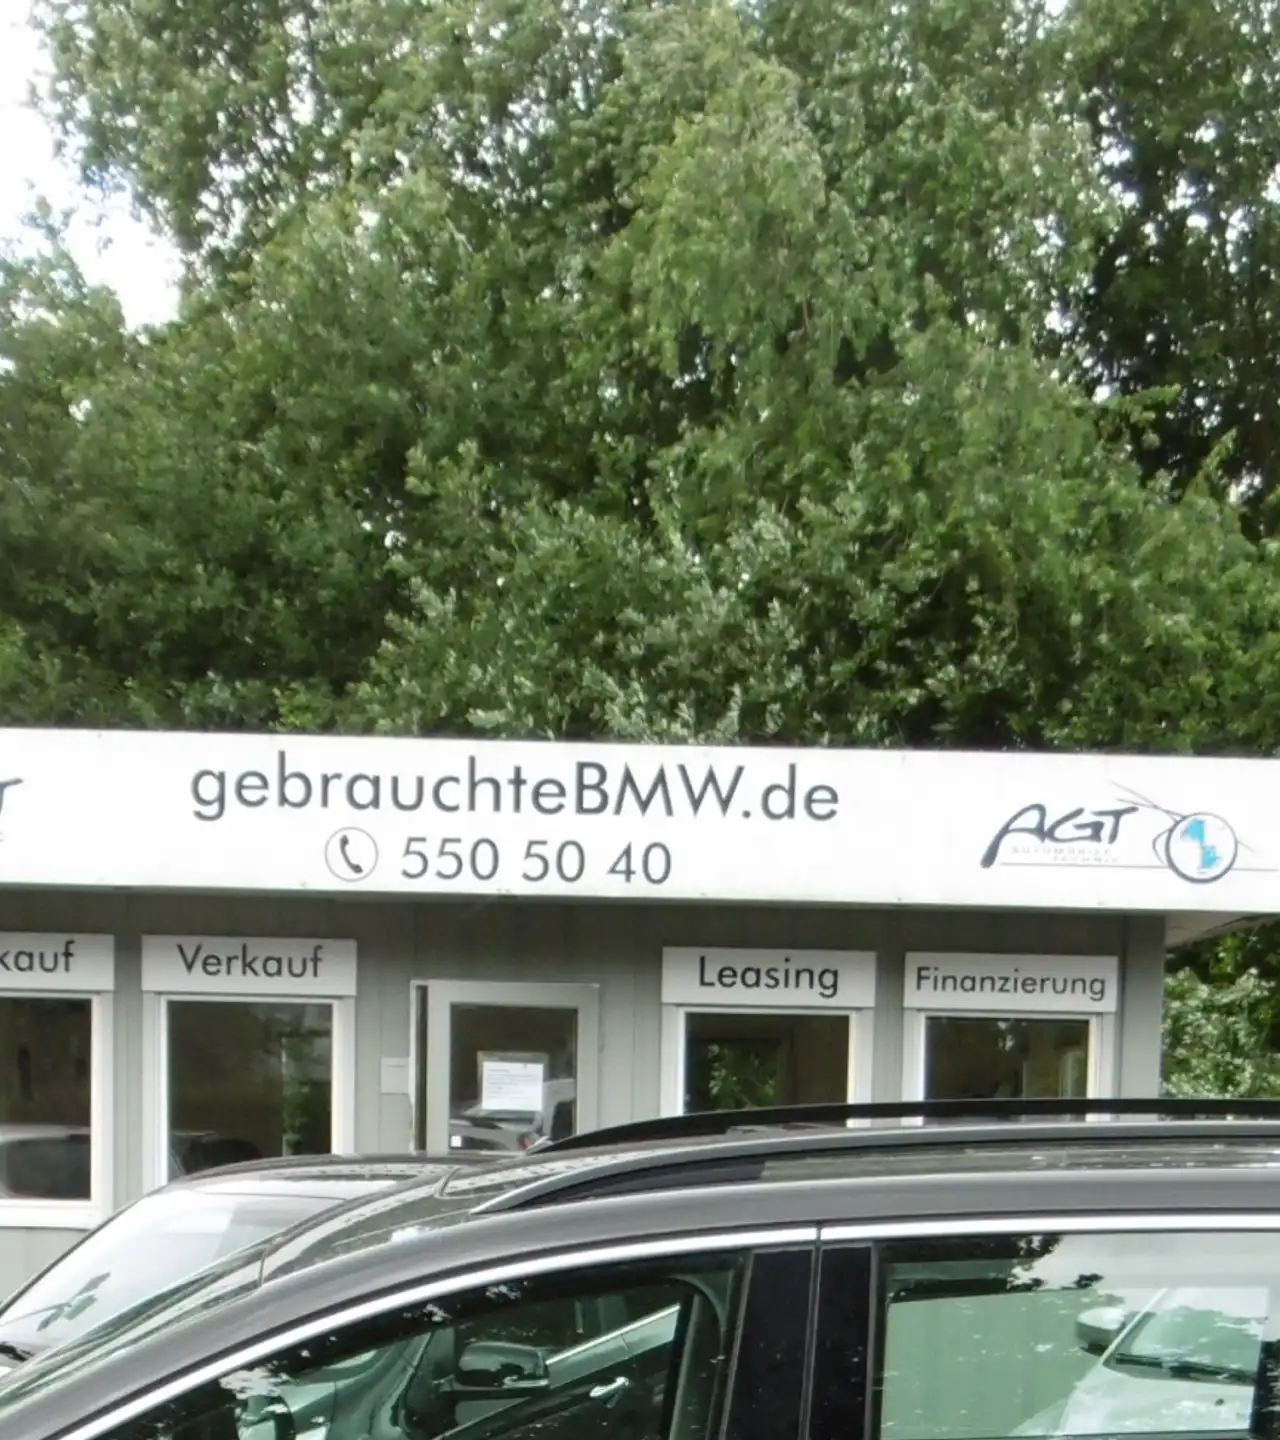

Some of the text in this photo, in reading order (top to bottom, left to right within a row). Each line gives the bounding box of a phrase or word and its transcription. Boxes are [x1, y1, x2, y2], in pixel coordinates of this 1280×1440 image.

[192, 751, 839, 820] gebrauchteBMW.de
[980, 802, 1139, 869] AGT
[401, 837, 672, 885] 550 50 40
[177, 943, 323, 979] Verkauf
[698, 955, 839, 999] Leasing
[916, 965, 1106, 1003] Finanzierung
